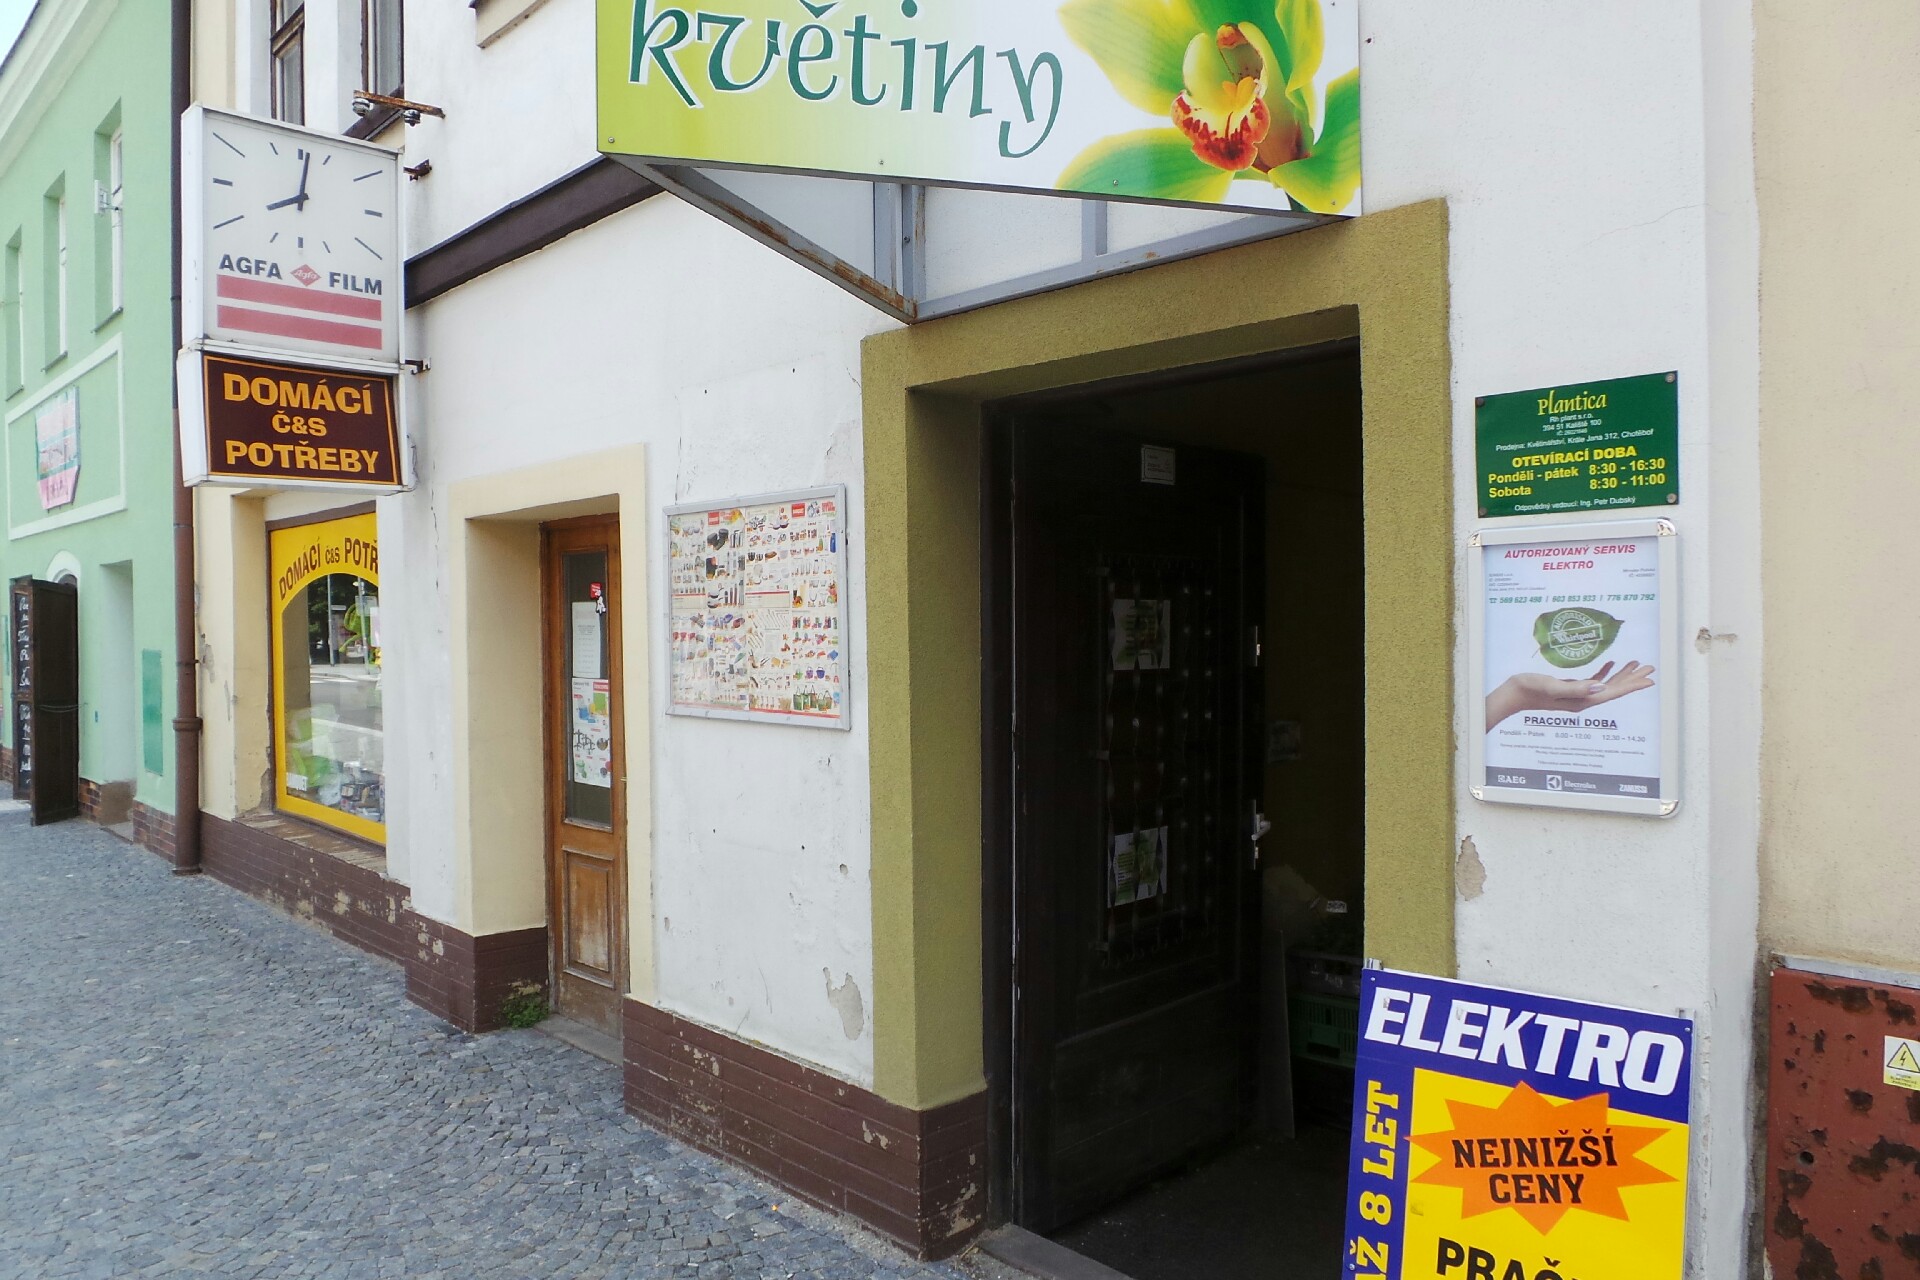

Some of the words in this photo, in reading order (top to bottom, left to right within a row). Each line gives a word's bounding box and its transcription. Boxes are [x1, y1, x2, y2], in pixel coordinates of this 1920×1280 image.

[628, 0, 1064, 158] květiny
[218, 254, 282, 280] AGFA
[329, 272, 382, 296] FILM
[223, 372, 373, 415] DOMÁCÍ
[1537, 390, 1608, 416] Plantica
[272, 410, 328, 437] Č&S
[1586, 434, 1603, 442] Jana
[225, 440, 378, 474] POTŘEBY
[1512, 447, 1590, 468] OTEVÍRACÍ
[1593, 445, 1637, 462] DOBA
[1544, 466, 1579, 482] pátek
[1588, 462, 1616, 476] 8:30
[1629, 458, 1666, 472] 16:30
[1488, 484, 1532, 498] Sobota
[1589, 477, 1618, 490] 8:30
[1630, 472, 1666, 486] 11:00
[1580, 500, 1592, 508] Ing.
[1594, 498, 1608, 506] Petr
[1504, 544, 1590, 559] AUTORIZOVANÝ
[1593, 544, 1636, 555] SERVIS
[279, 536, 321, 600] DOMÁCÍ
[1542, 560, 1594, 571] ELEKTRO
[1552, 630, 1596, 644] Whirlpool
[1524, 716, 1580, 727] PRACOVNÍ
[1584, 718, 1618, 729] DOBA
[1504, 775, 1526, 785] AEG
[1364, 986, 1685, 1096] ELEKTRO
[1362, 1080, 1399, 1180] LET
[1452, 1127, 1619, 1170] NEJNIŽŠÍ
[1488, 1173, 1585, 1204] CENY
[1360, 1191, 1392, 1226] 8
